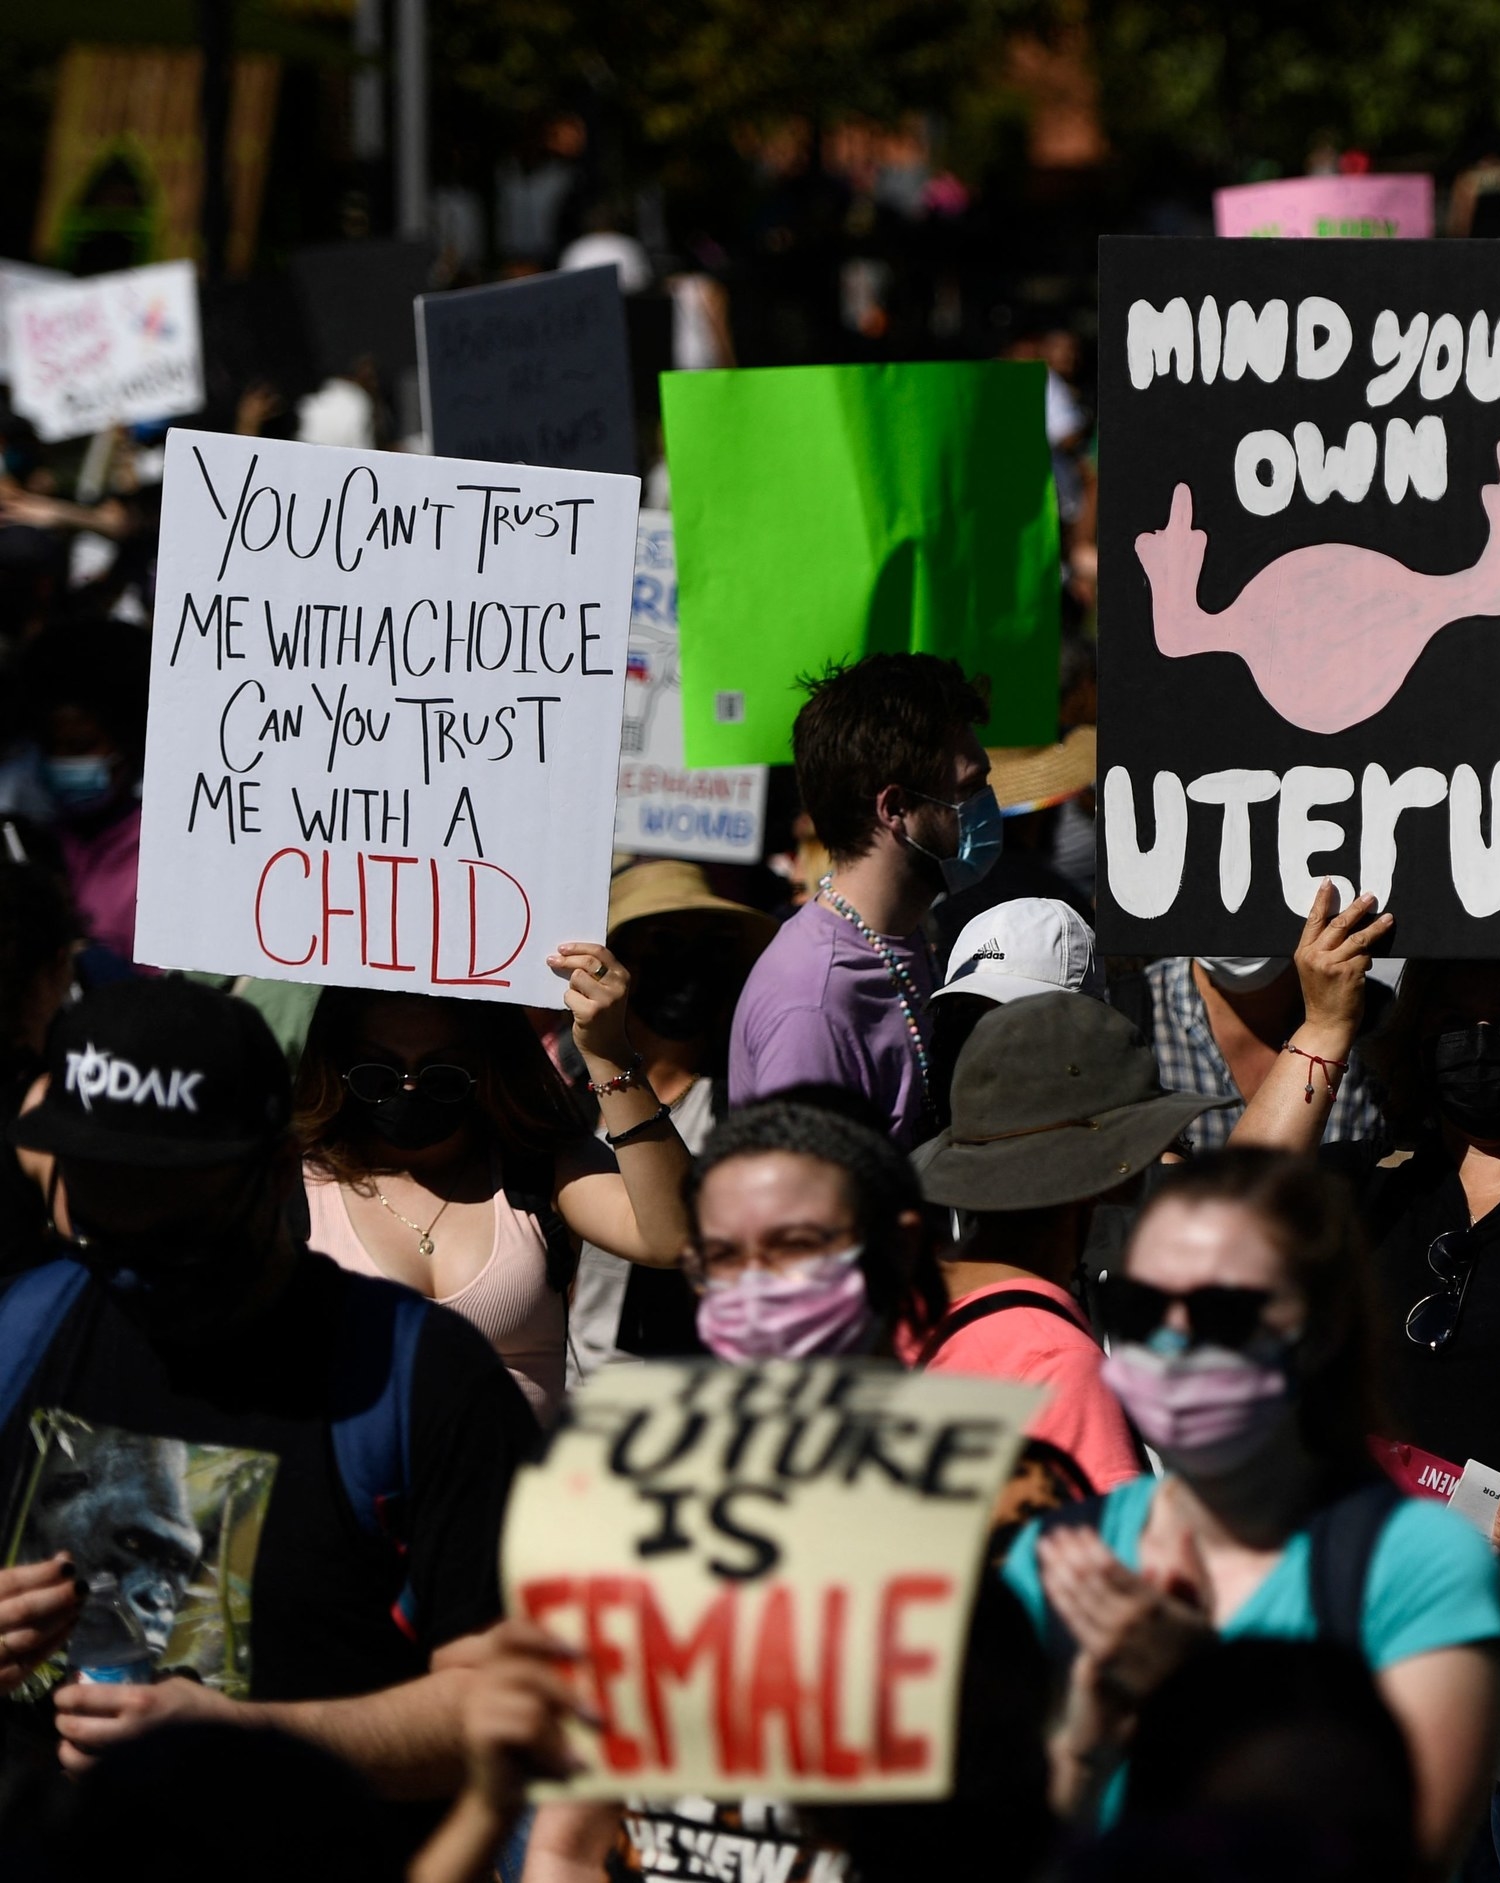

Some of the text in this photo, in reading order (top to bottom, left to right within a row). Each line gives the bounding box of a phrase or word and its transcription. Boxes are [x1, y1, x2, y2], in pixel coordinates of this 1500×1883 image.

[1127, 295, 1353, 390] MIND
[192, 446, 331, 581] YOU
[457, 484, 595, 574] TRUST
[1234, 415, 1448, 516] OWN
[169, 593, 250, 670] ME
[264, 600, 363, 670] WITH
[367, 605, 398, 686] A
[402, 599, 614, 677] CHOICE
[219, 679, 562, 785] CAN YOU TRUST
[188, 772, 484, 857] ME WITH A
[254, 847, 531, 987] CHILD
[973, 950, 1005, 960] adidas
[635, 1485, 788, 1582] IS
[518, 1572, 954, 1784] FEMALE
